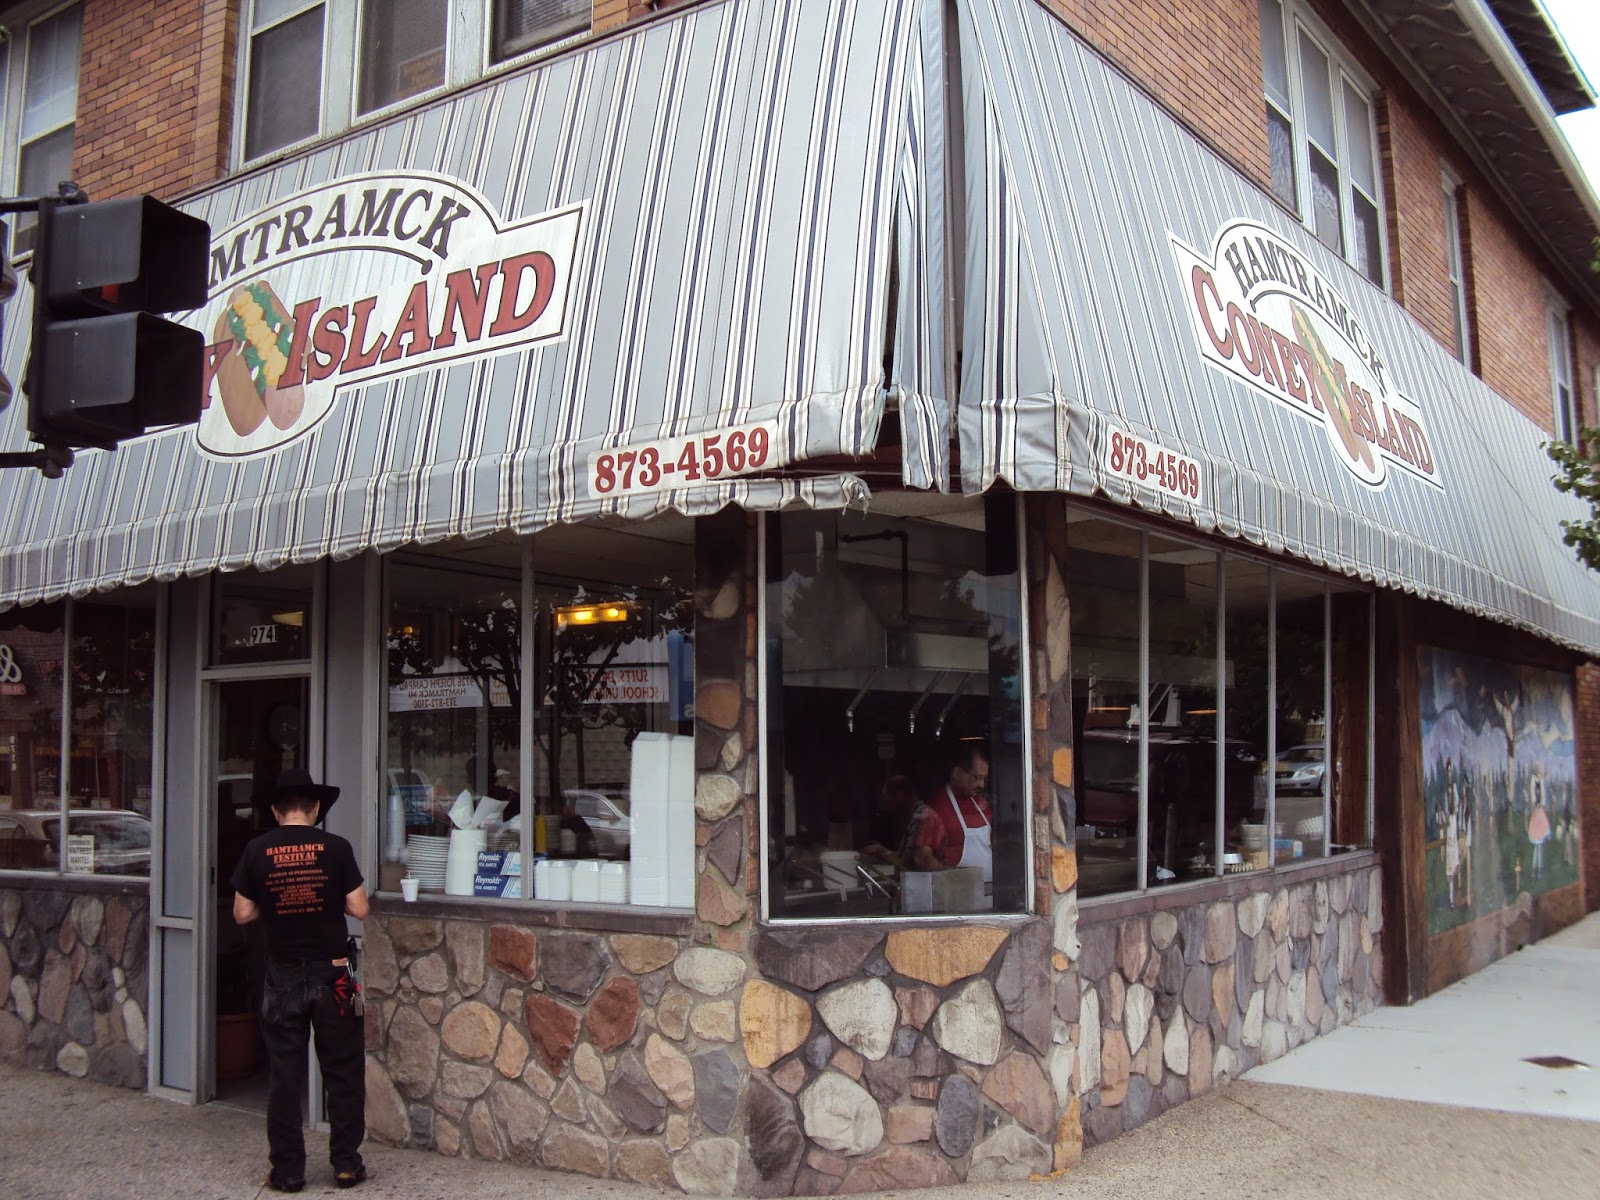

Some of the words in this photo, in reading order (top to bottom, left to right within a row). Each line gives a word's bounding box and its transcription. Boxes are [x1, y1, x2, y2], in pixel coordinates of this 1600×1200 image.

[209, 188, 471, 290] MTRAMCK
[276, 251, 556, 390] ISLAND
[1225, 236, 1388, 398] HAMTRAMCK
[1192, 265, 1325, 414] CONEY
[1333, 358, 1434, 475] ISLAND
[595, 427, 769, 493] 873-4569
[1110, 431, 1199, 499] 873-4569
[251, 626, 277, 643] 9741
[266, 844, 325, 856] HAMTRAMCK
[273, 851, 317, 864] FESTIVAL
[474, 876, 502, 885] Reynolds
[478, 853, 502, 862] Reynolds
